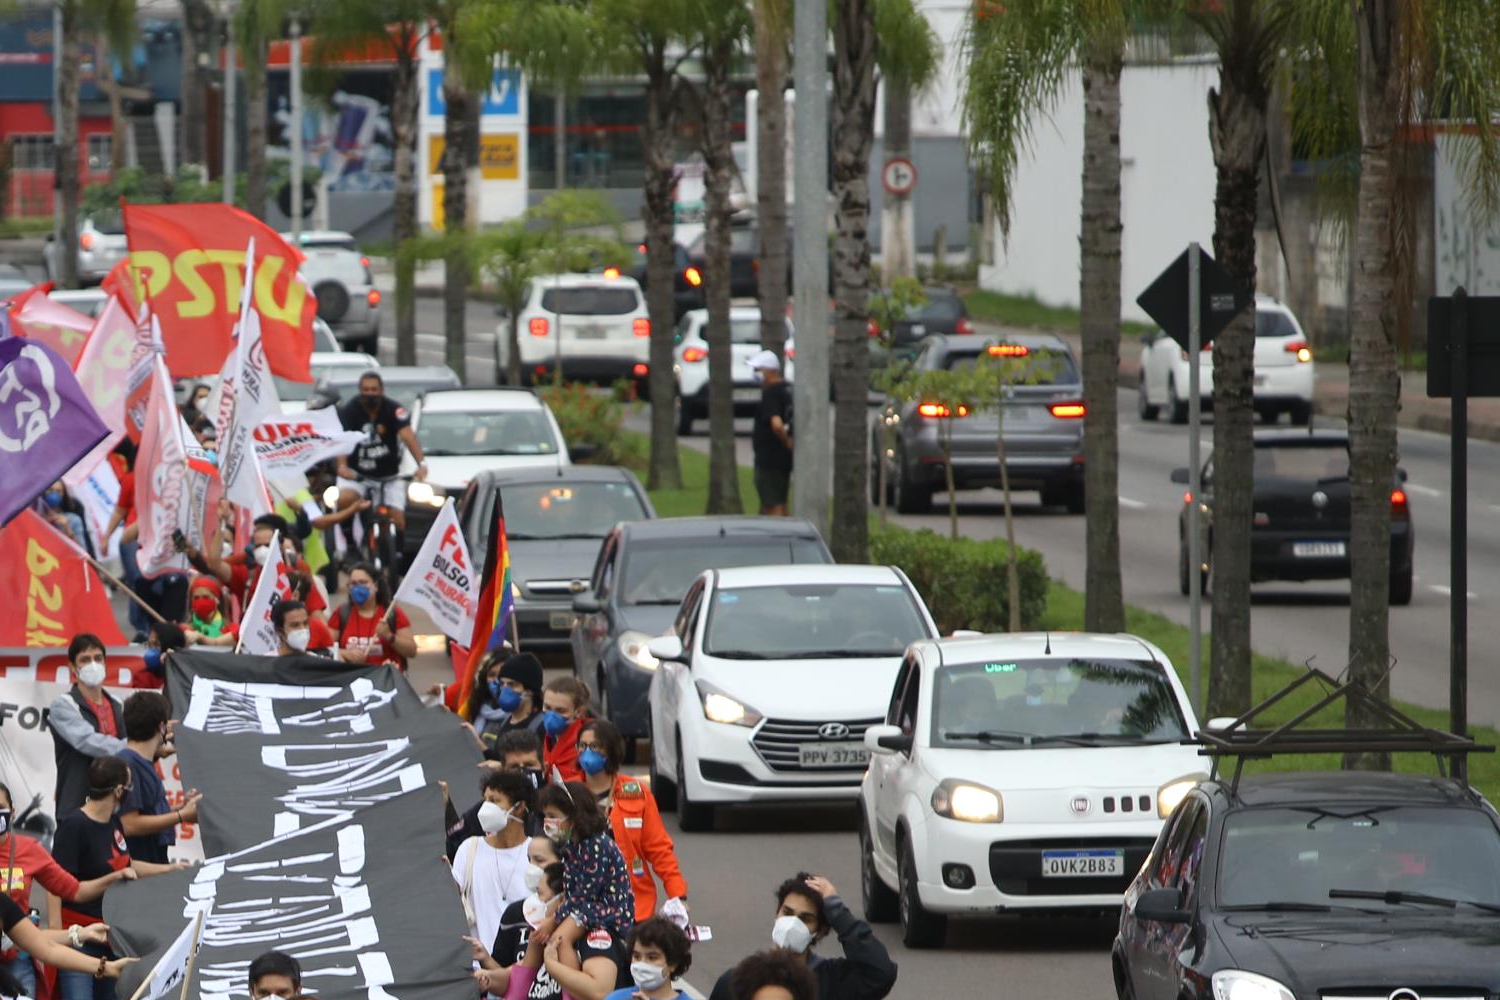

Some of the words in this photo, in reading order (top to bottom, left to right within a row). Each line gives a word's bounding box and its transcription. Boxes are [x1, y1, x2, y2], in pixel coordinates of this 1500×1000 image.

[129, 249, 306, 328] PSTU
[984, 662, 1018, 674] Uber
[1050, 858, 1117, 874] OVK2B83
